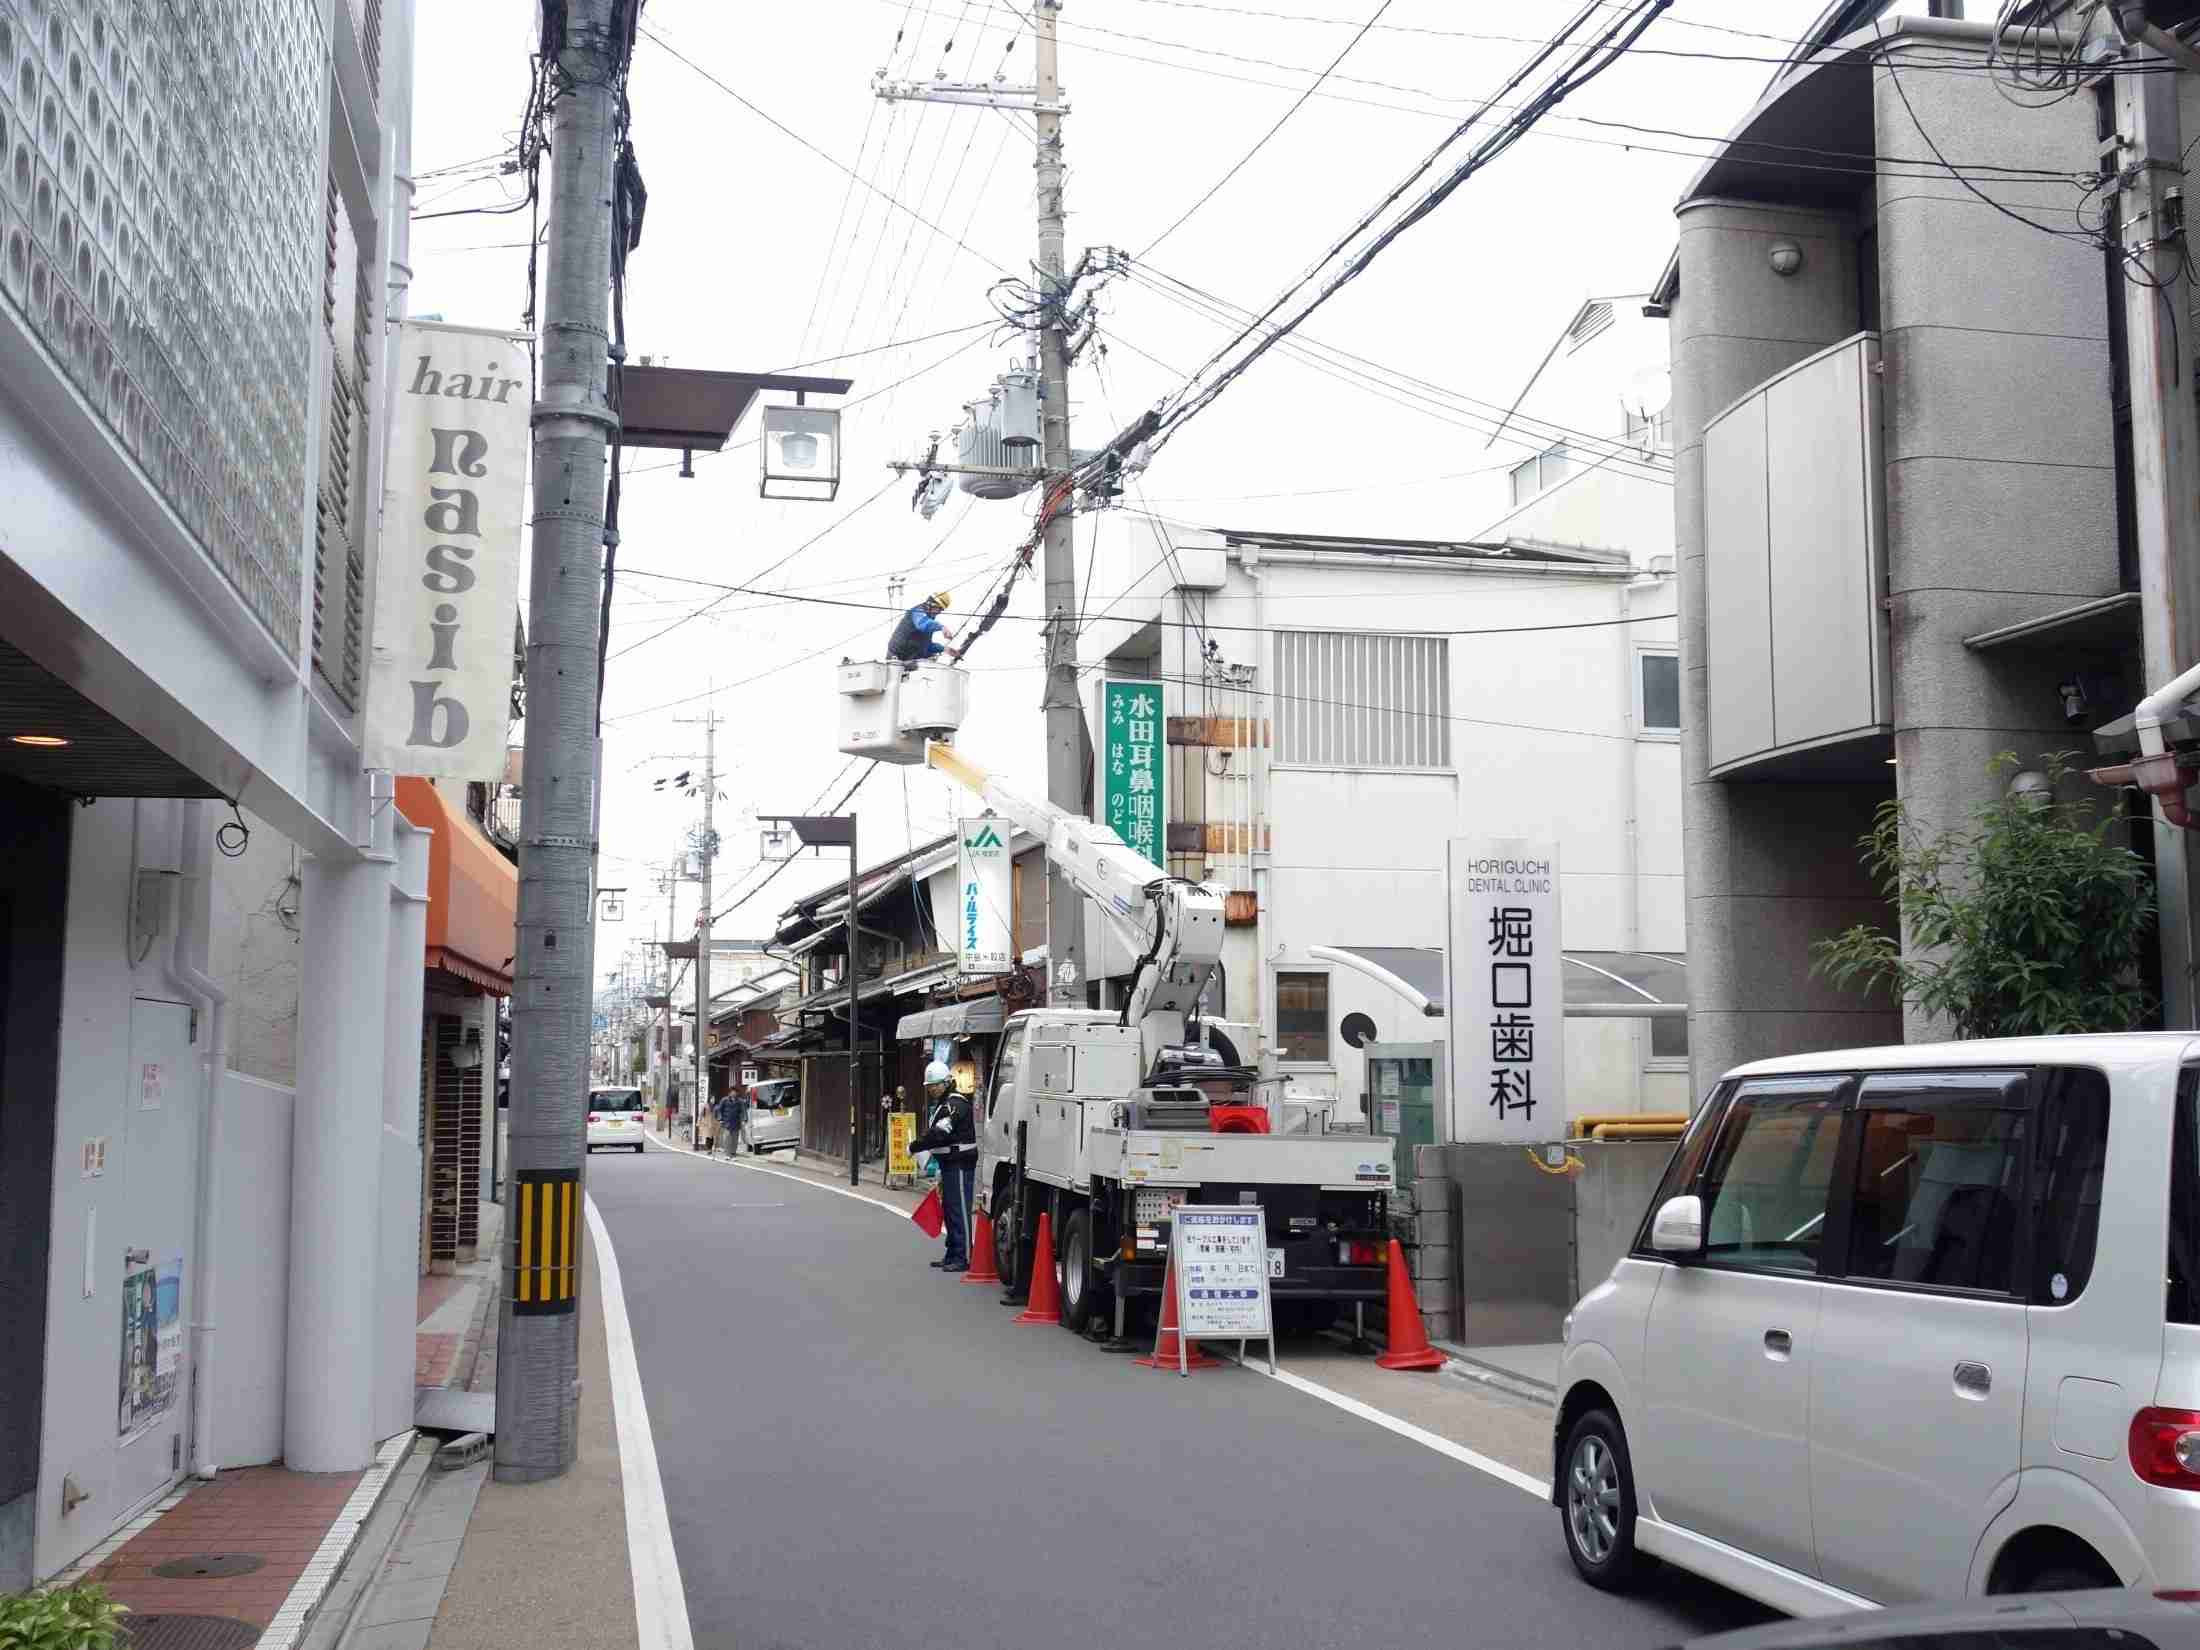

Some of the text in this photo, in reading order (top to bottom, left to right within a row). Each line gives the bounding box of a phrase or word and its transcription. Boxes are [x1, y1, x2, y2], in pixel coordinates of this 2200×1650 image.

[407, 356, 522, 404] hair
[406, 428, 488, 748] nasib
[1112, 694, 1124, 824] みみ はな のど
[1468, 859, 1549, 874] HORIGUCHI
[1468, 878, 1551, 893] DENTAL CLINIC
[1488, 906, 1537, 1121] 堀口歯科
